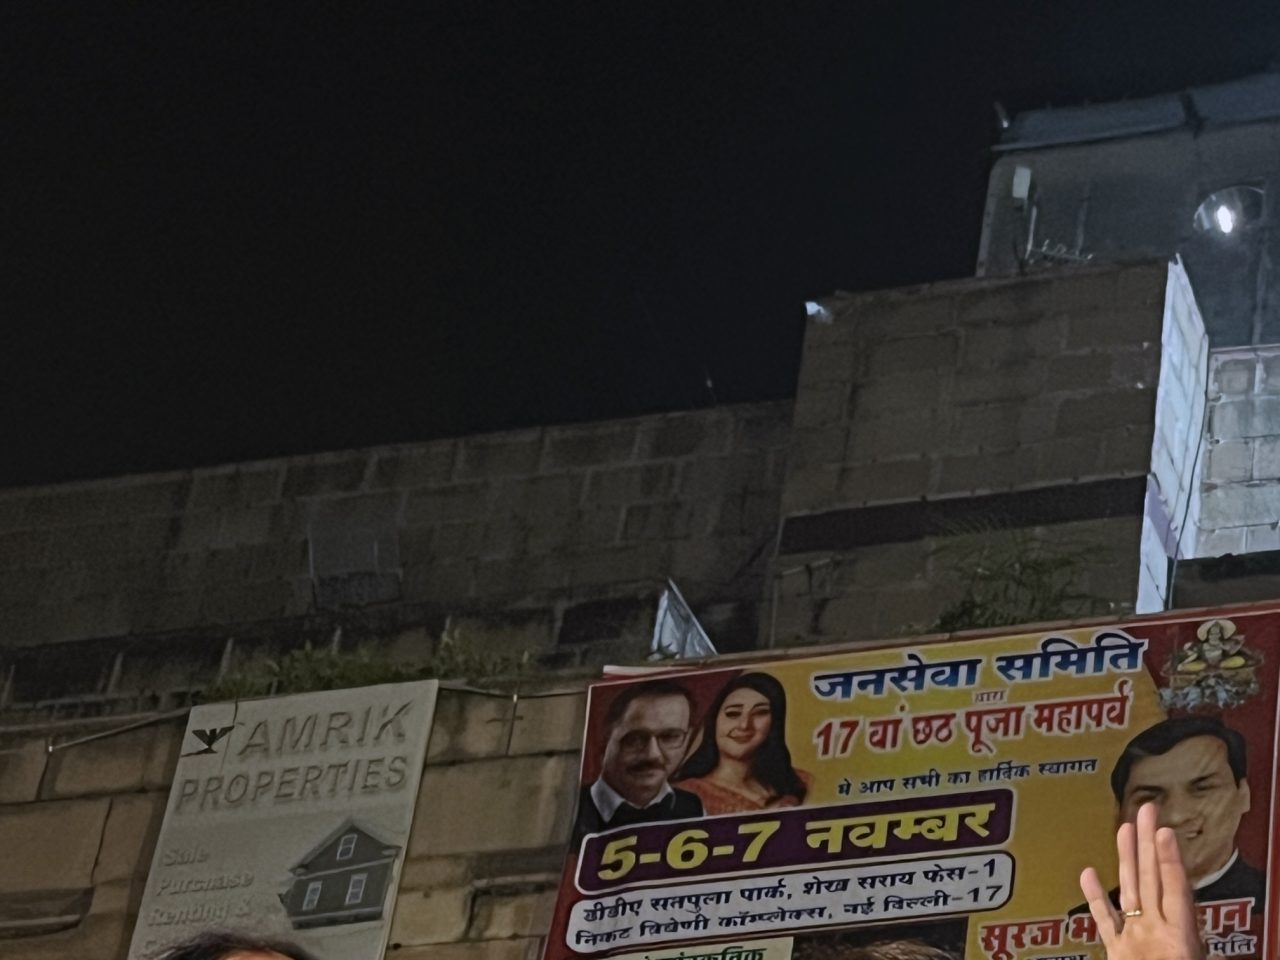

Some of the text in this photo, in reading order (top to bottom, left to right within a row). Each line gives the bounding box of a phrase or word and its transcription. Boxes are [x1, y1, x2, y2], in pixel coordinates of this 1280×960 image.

[814, 632, 1146, 699] जनसेवा समिति
[237, 699, 413, 760] AMRIK
[816, 720, 861, 758] 17
[911, 712, 957, 746] छठ
[965, 706, 1026, 754] पूजा
[1034, 680, 1133, 734] महापर्व
[175, 755, 409, 815] PROPERTIES
[859, 774, 897, 794] आप
[597, 802, 996, 881] 5-6-7 नवम्बर
[803, 875, 849, 895] शेख
[858, 871, 915, 890] सराय
[575, 926, 633, 946] निकट
[843, 896, 875, 915] नई
[980, 918, 1065, 960] सूरज
